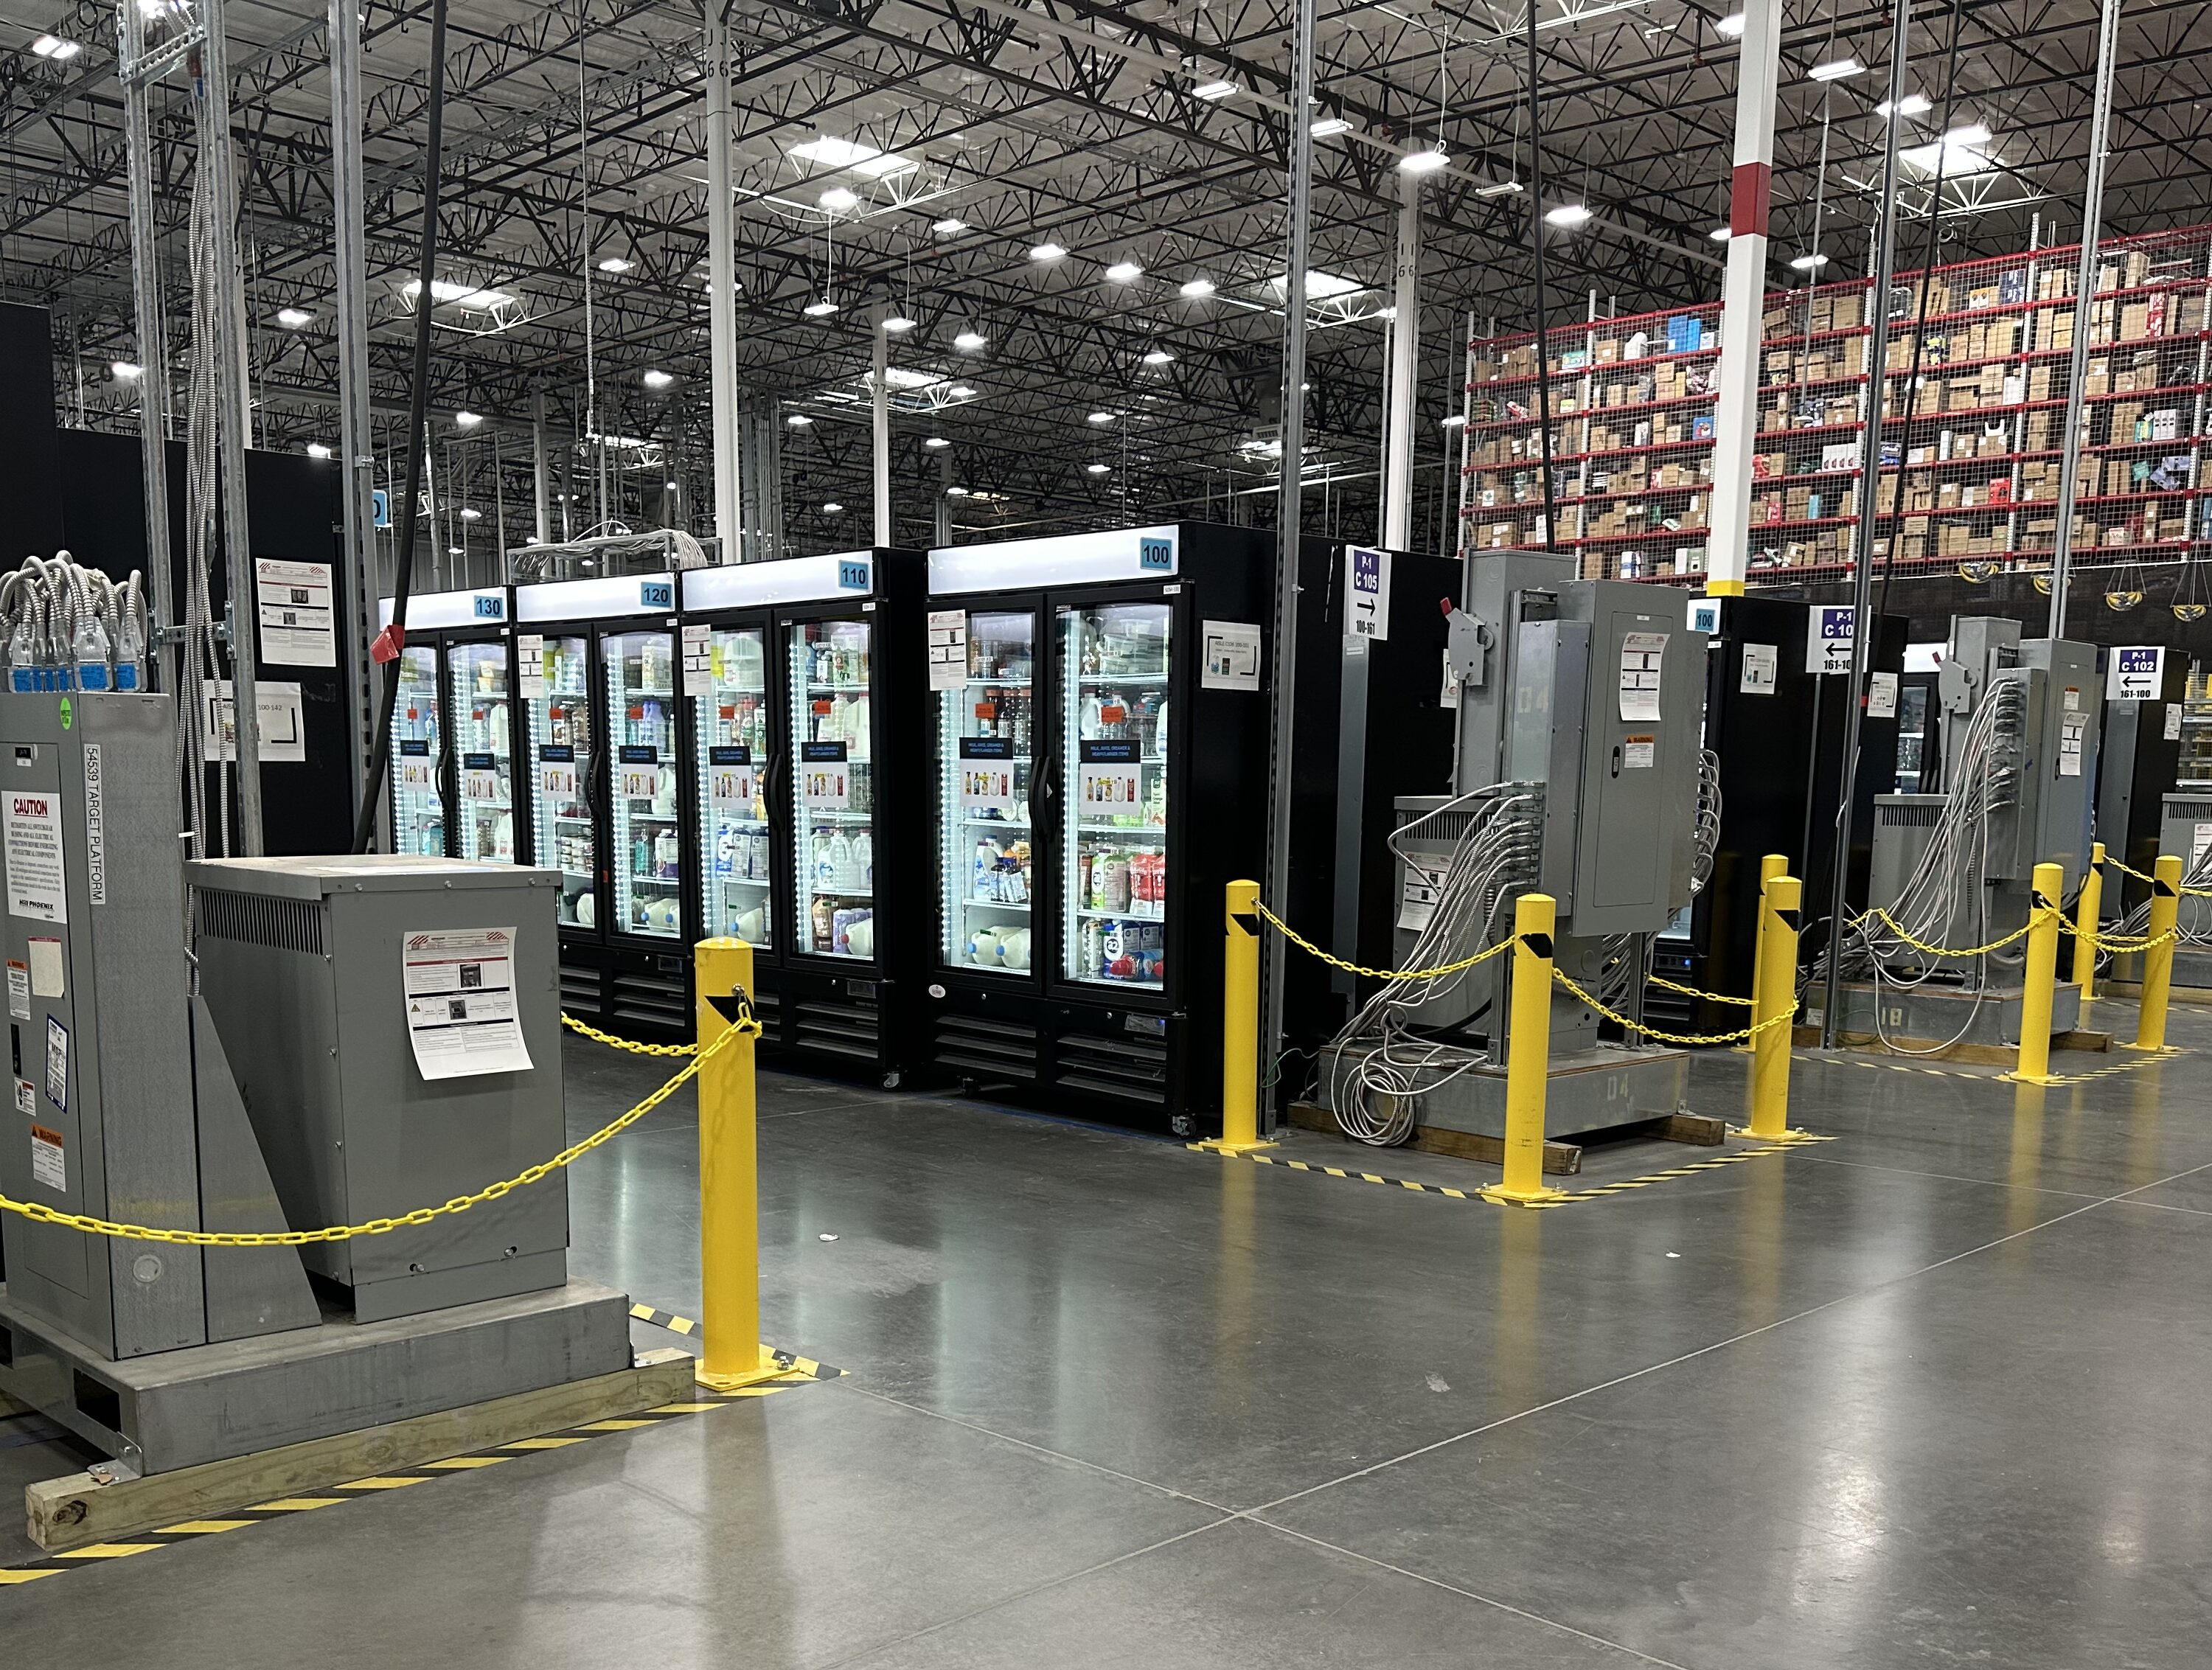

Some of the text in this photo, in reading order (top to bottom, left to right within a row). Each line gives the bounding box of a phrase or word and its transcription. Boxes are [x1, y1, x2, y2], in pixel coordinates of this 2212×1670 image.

[707, 60, 714, 78] 6
[1398, 265, 1405, 278] 6
[1408, 264, 1414, 277] 6
[1144, 544, 1169, 564] 100
[1361, 555, 1372, 570] P-1
[842, 567, 866, 585] 110
[1355, 571, 1378, 591] C 105
[644, 587, 669, 603] 120
[476, 598, 501, 616] 130
[1697, 613, 1713, 627] 100
[1836, 611, 1852, 622] P-1
[1356, 619, 1376, 636] 100-161
[1824, 624, 1854, 636] C 10
[2132, 651, 2146, 660] P-1
[1823, 659, 1851, 670] 161-10
[2121, 661, 2154, 672] C 102
[2121, 689, 2151, 698] 161-100
[13, 798, 48, 816] CAUTION
[87, 747, 102, 901] 54539 TARGET PLATFORM
[29, 900, 54, 910] PHOENIX
